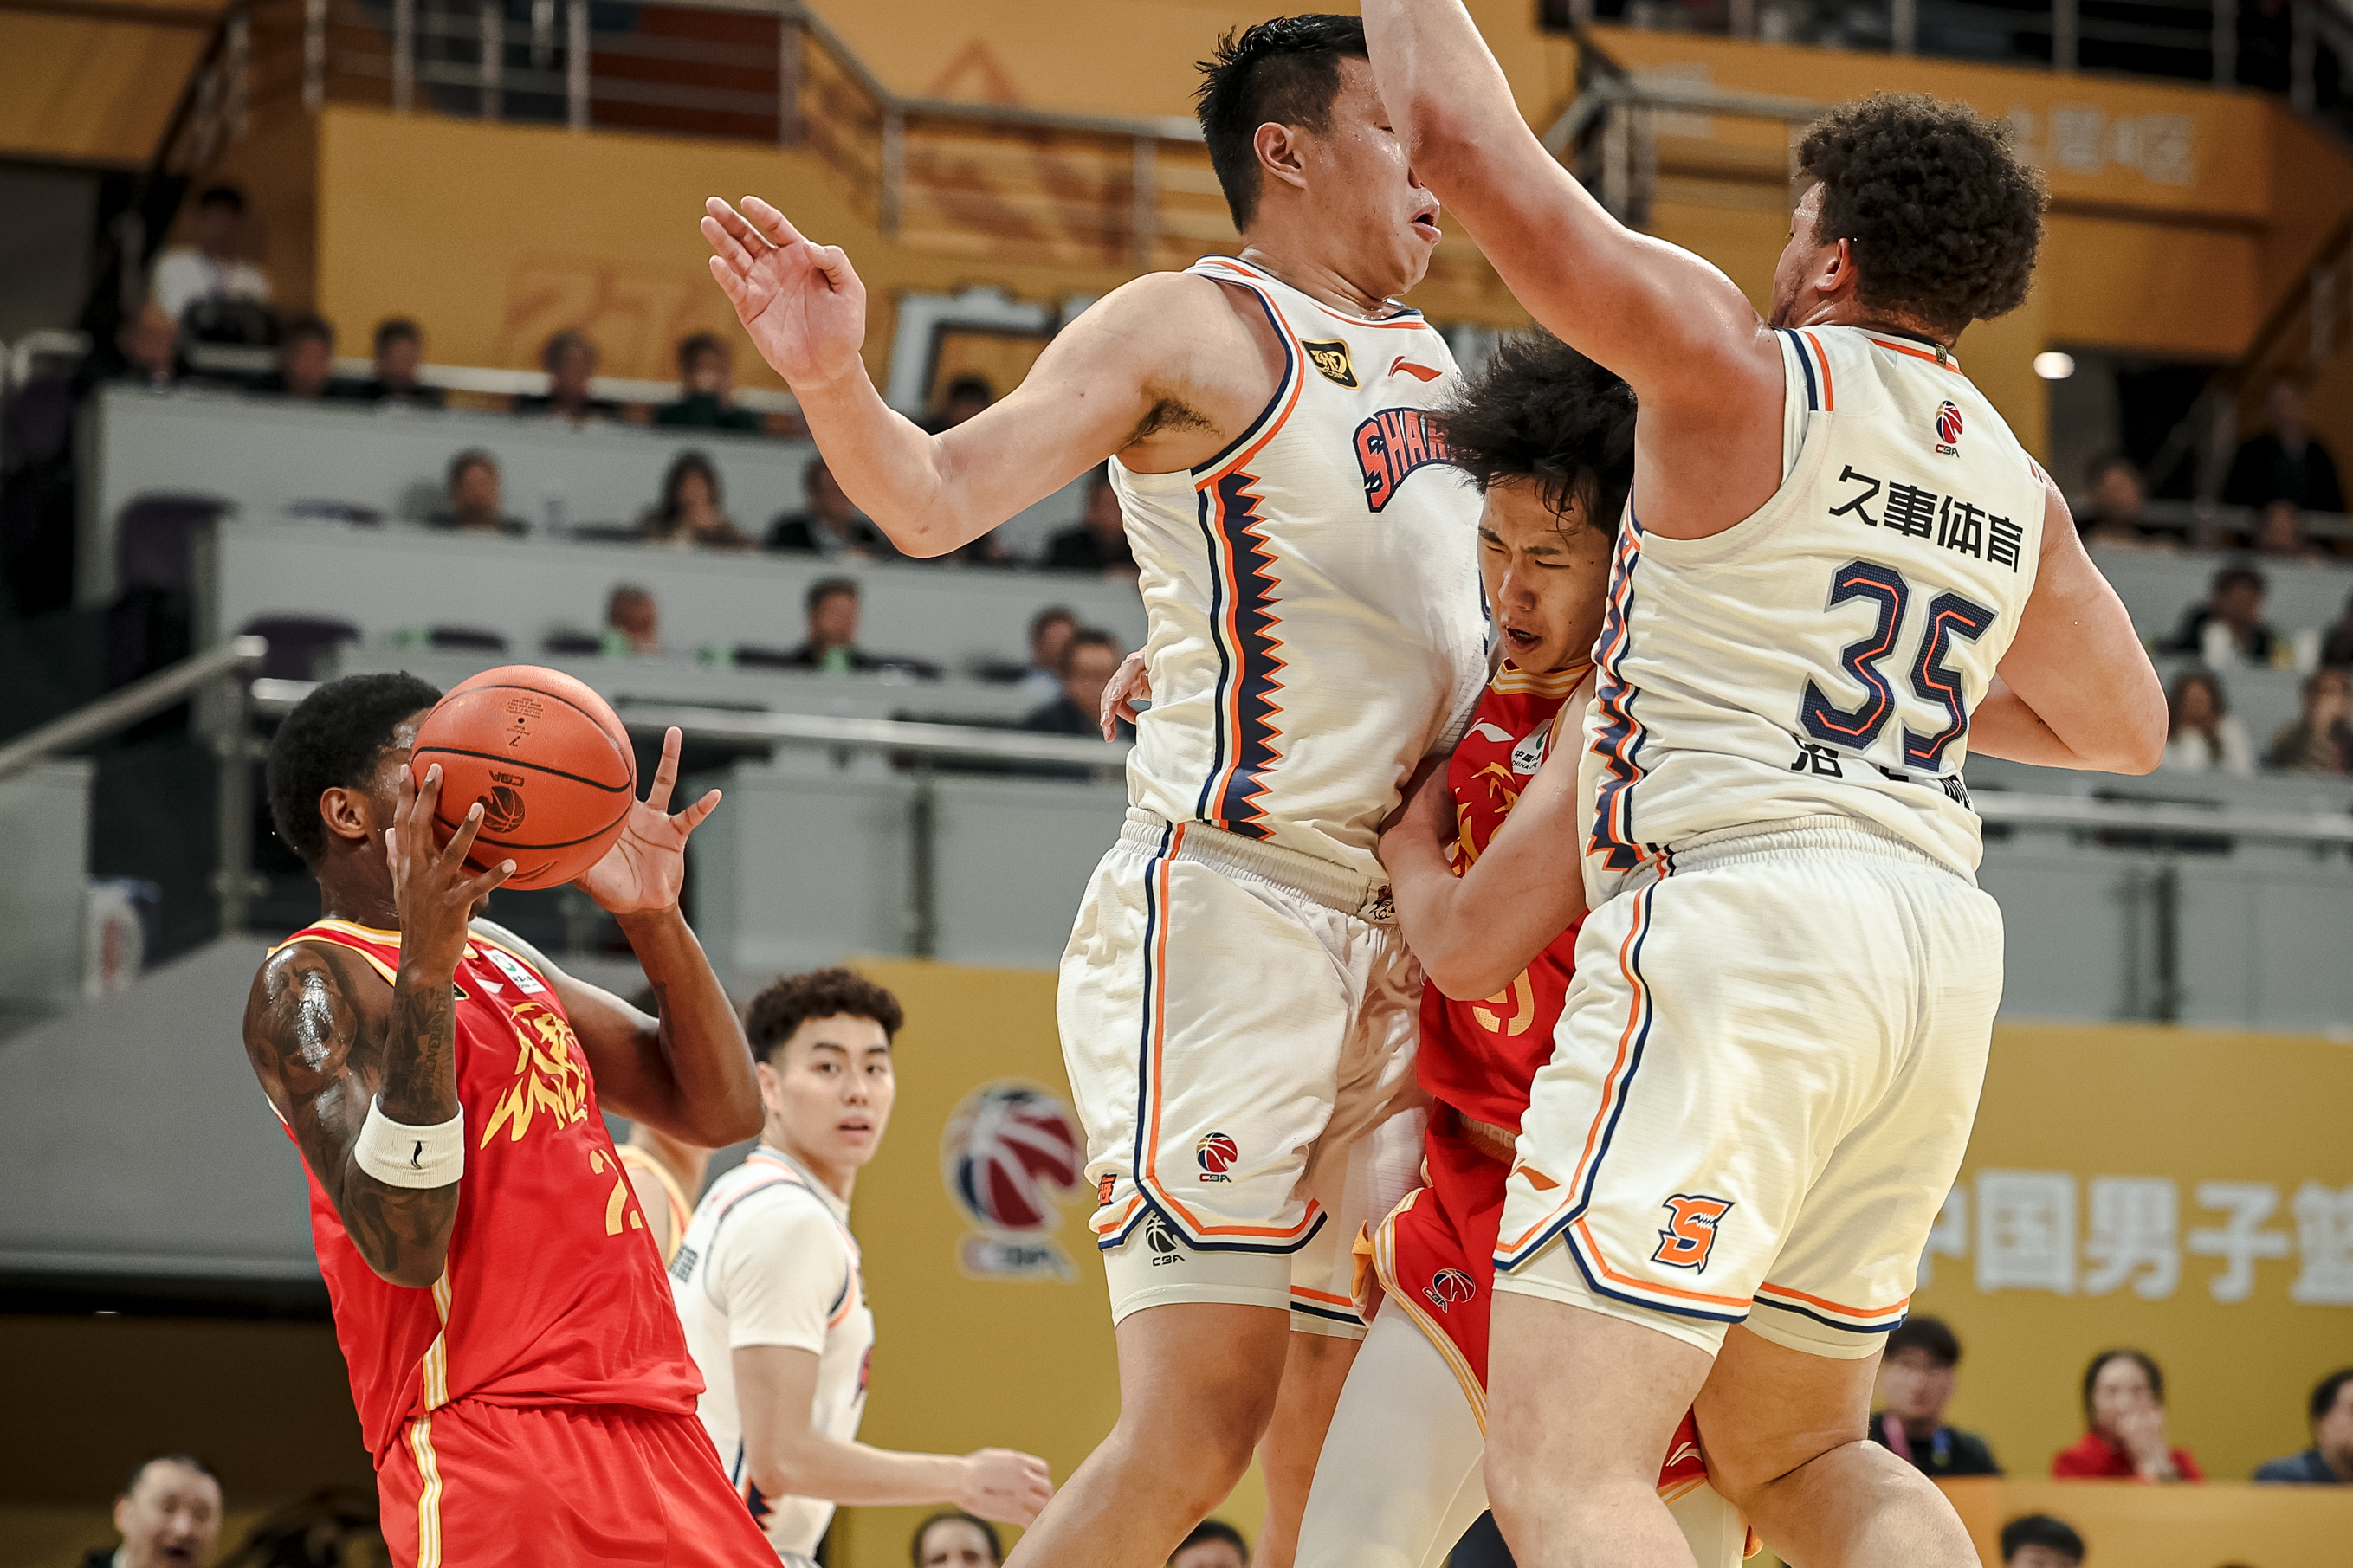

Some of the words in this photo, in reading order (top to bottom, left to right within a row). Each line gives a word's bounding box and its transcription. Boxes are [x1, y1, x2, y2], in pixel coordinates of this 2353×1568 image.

[1935, 443, 1960, 458] CBA
[1828, 464, 2024, 573] 久事体育
[1795, 556, 2000, 773] 35
[488, 770, 525, 787] CBA
[1199, 1173, 1232, 1184] CBA
[1153, 1255, 1186, 1267] CBA
[1421, 1286, 1448, 1313] CBA
